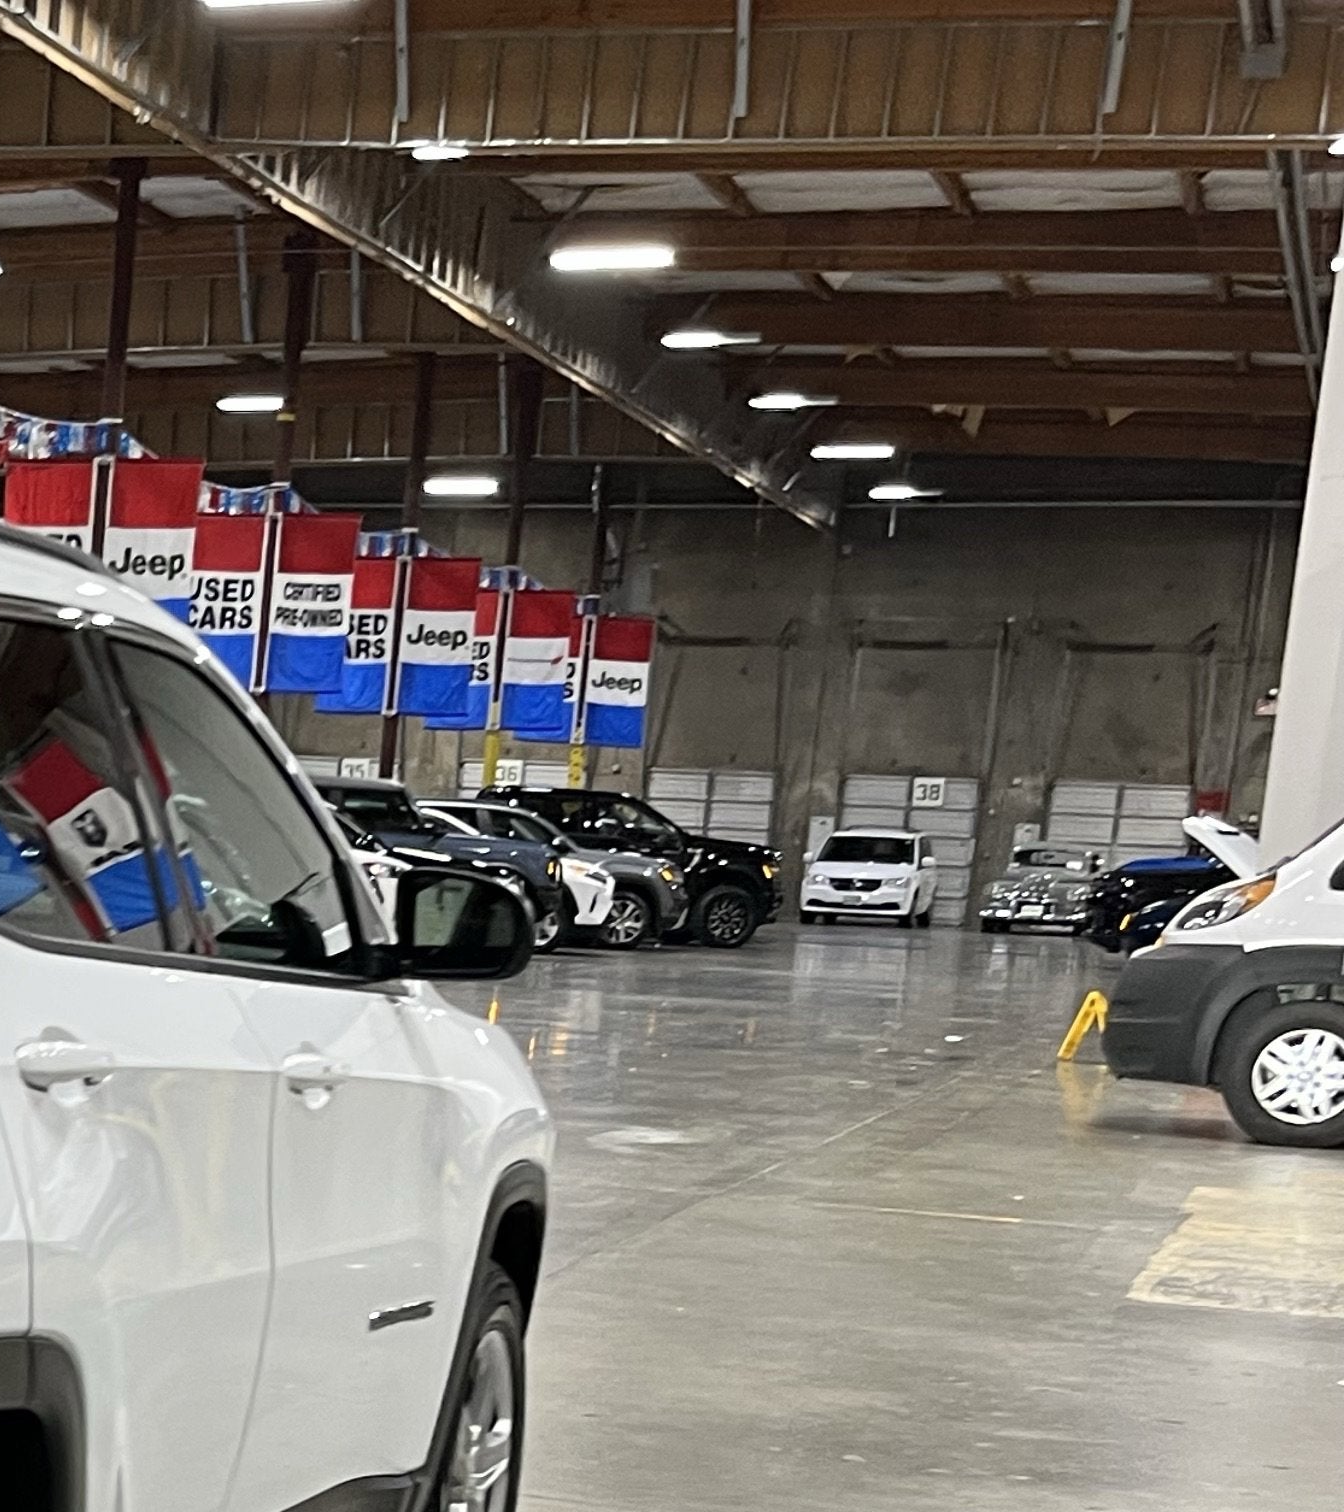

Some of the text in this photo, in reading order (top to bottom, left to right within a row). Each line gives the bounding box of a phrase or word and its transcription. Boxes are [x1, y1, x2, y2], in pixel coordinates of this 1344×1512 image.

[109, 547, 185, 581] Jeep
[188, 605, 253, 629] CARS
[406, 624, 468, 651] Jeep
[591, 672, 643, 695] Jeep
[495, 765, 517, 782] 36
[915, 783, 941, 801] 38
